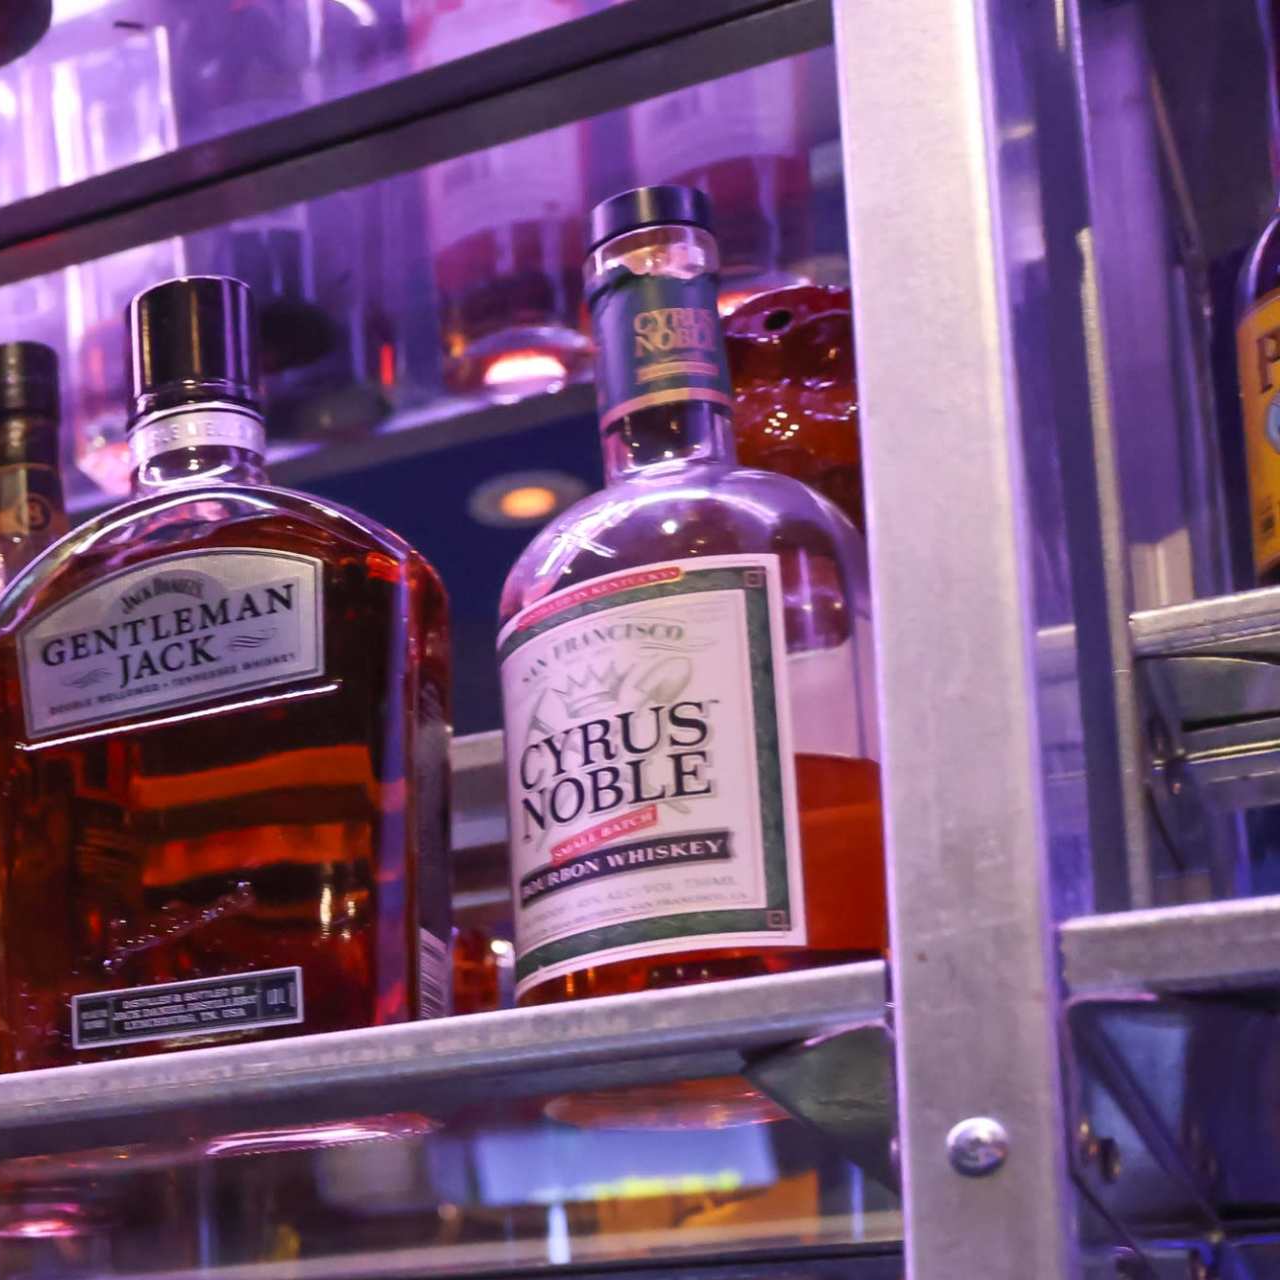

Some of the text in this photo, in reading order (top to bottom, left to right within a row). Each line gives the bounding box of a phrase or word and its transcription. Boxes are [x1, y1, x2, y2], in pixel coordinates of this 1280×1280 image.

[634, 308, 716, 333] CYRUS
[635, 331, 717, 357] NOBLE
[42, 583, 295, 667] GENTLEMAN
[552, 622, 684, 660] FRANCISCO
[120, 634, 219, 689] JACK
[242, 653, 295, 671] WHISKEY
[521, 701, 708, 790] CYRUS
[522, 750, 713, 840] NOBLE
[553, 811, 654, 857] SMALL BATCH
[523, 838, 725, 898] BOURBON WHISKEY
